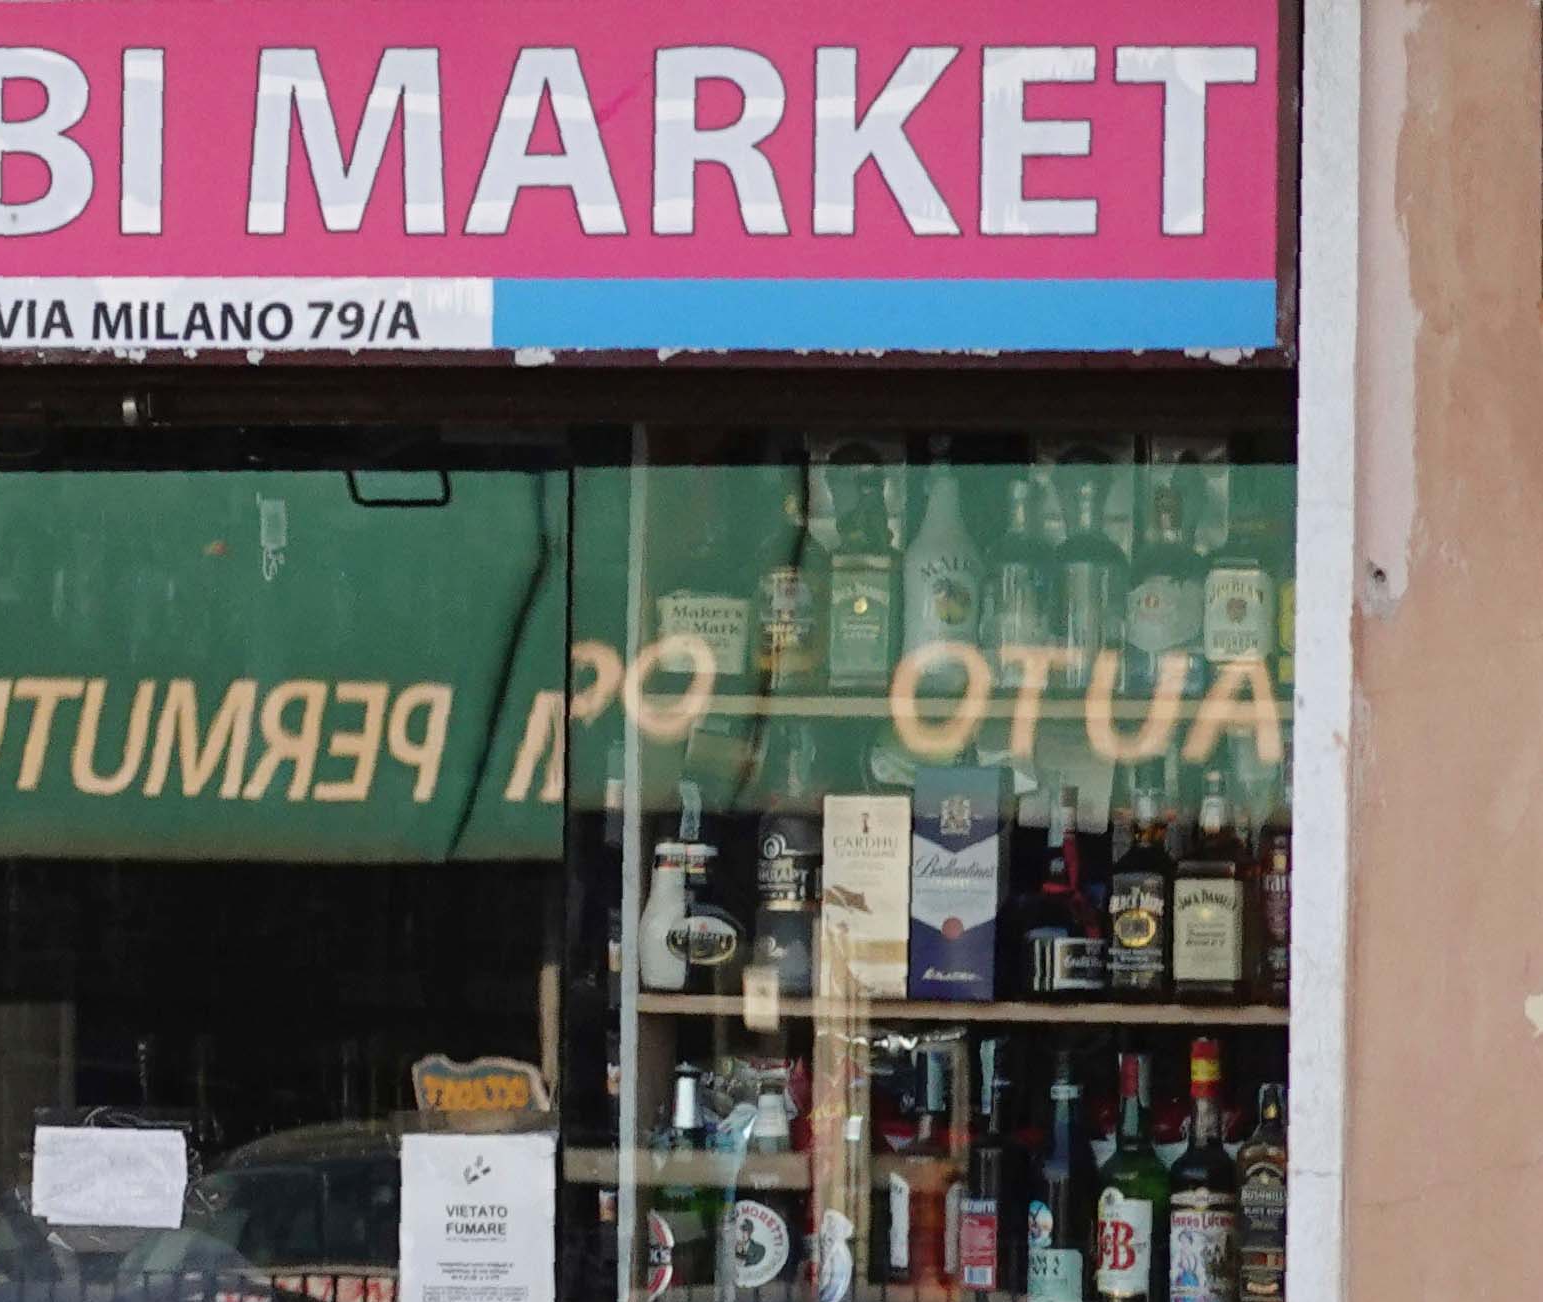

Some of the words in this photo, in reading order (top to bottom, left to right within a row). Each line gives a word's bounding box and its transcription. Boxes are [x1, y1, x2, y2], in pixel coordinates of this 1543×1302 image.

[246, 46, 1258, 238] MARKET
[89, 300, 295, 342] MILANO
[305, 298, 421, 344] 79/A
[445, 1204, 508, 1219] VIETATO
[445, 1222, 507, 1236] FUMARE
